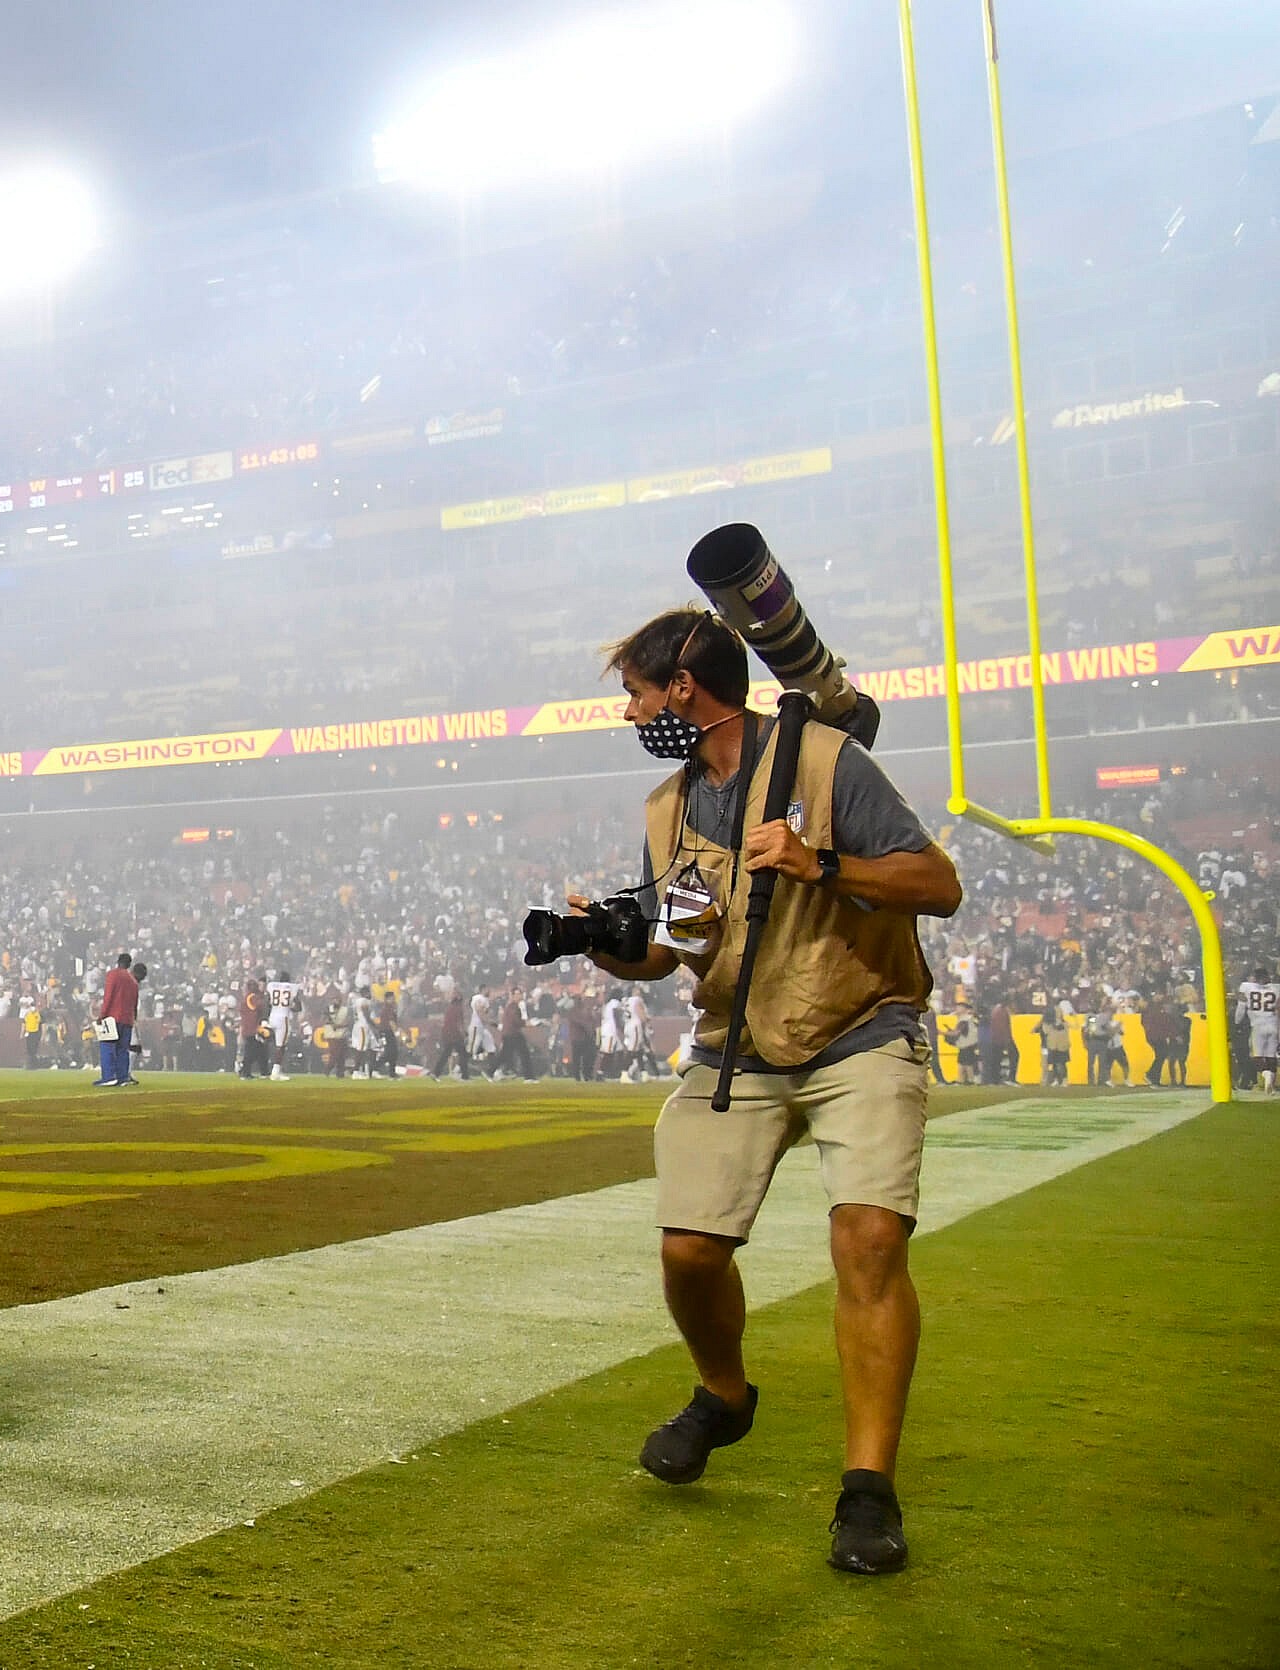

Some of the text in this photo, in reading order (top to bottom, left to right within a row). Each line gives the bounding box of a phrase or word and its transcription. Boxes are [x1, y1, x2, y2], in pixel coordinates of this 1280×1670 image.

[152, 457, 221, 488] FedEx
[859, 642, 1157, 701] WASHNGTON WINS
[290, 709, 507, 753] WASHINGTON WINS
[60, 737, 255, 767] WASHINGTON
[272, 989, 291, 1007] 83
[1250, 991, 1276, 1012] 82
